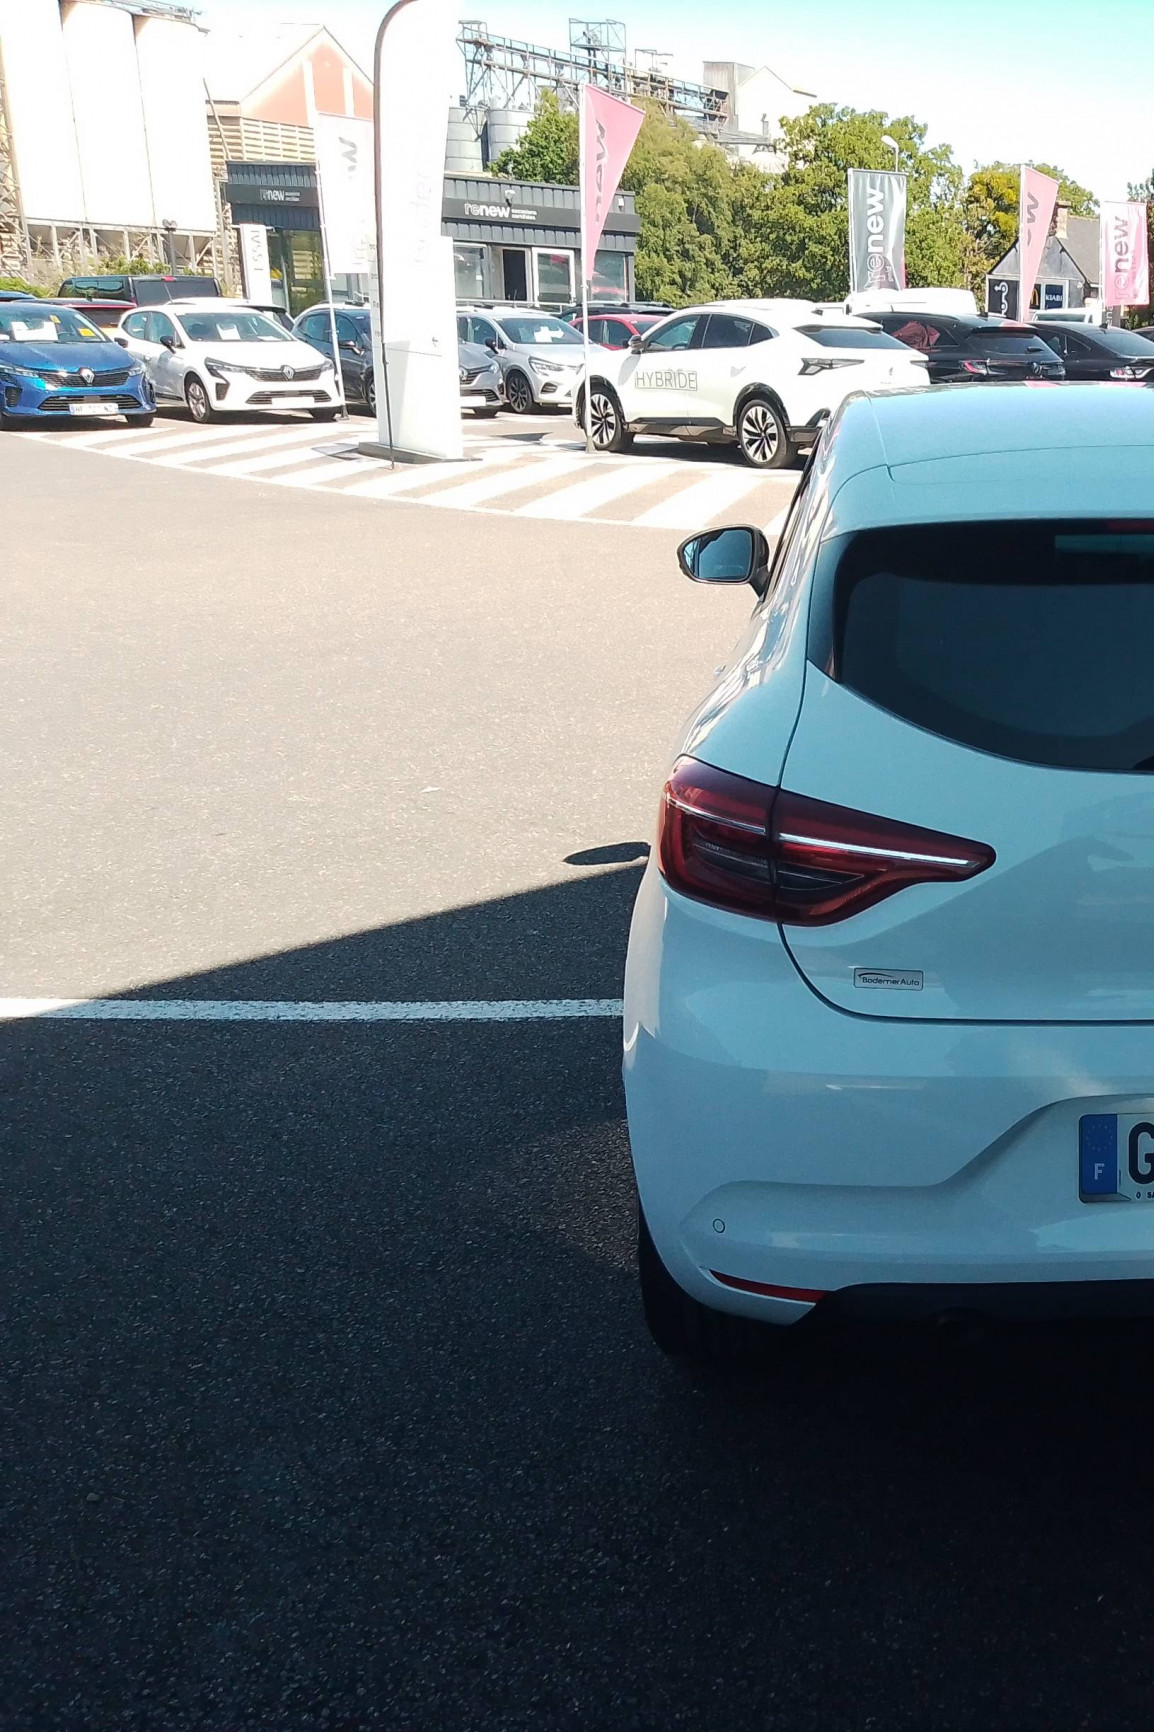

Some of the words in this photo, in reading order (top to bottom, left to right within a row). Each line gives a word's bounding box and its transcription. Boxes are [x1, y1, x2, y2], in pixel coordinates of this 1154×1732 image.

[463, 202, 511, 219] renew
[866, 187, 885, 283] renew
[636, 370, 697, 389] HYBRIDE
[1093, 1163, 1105, 1180] F
